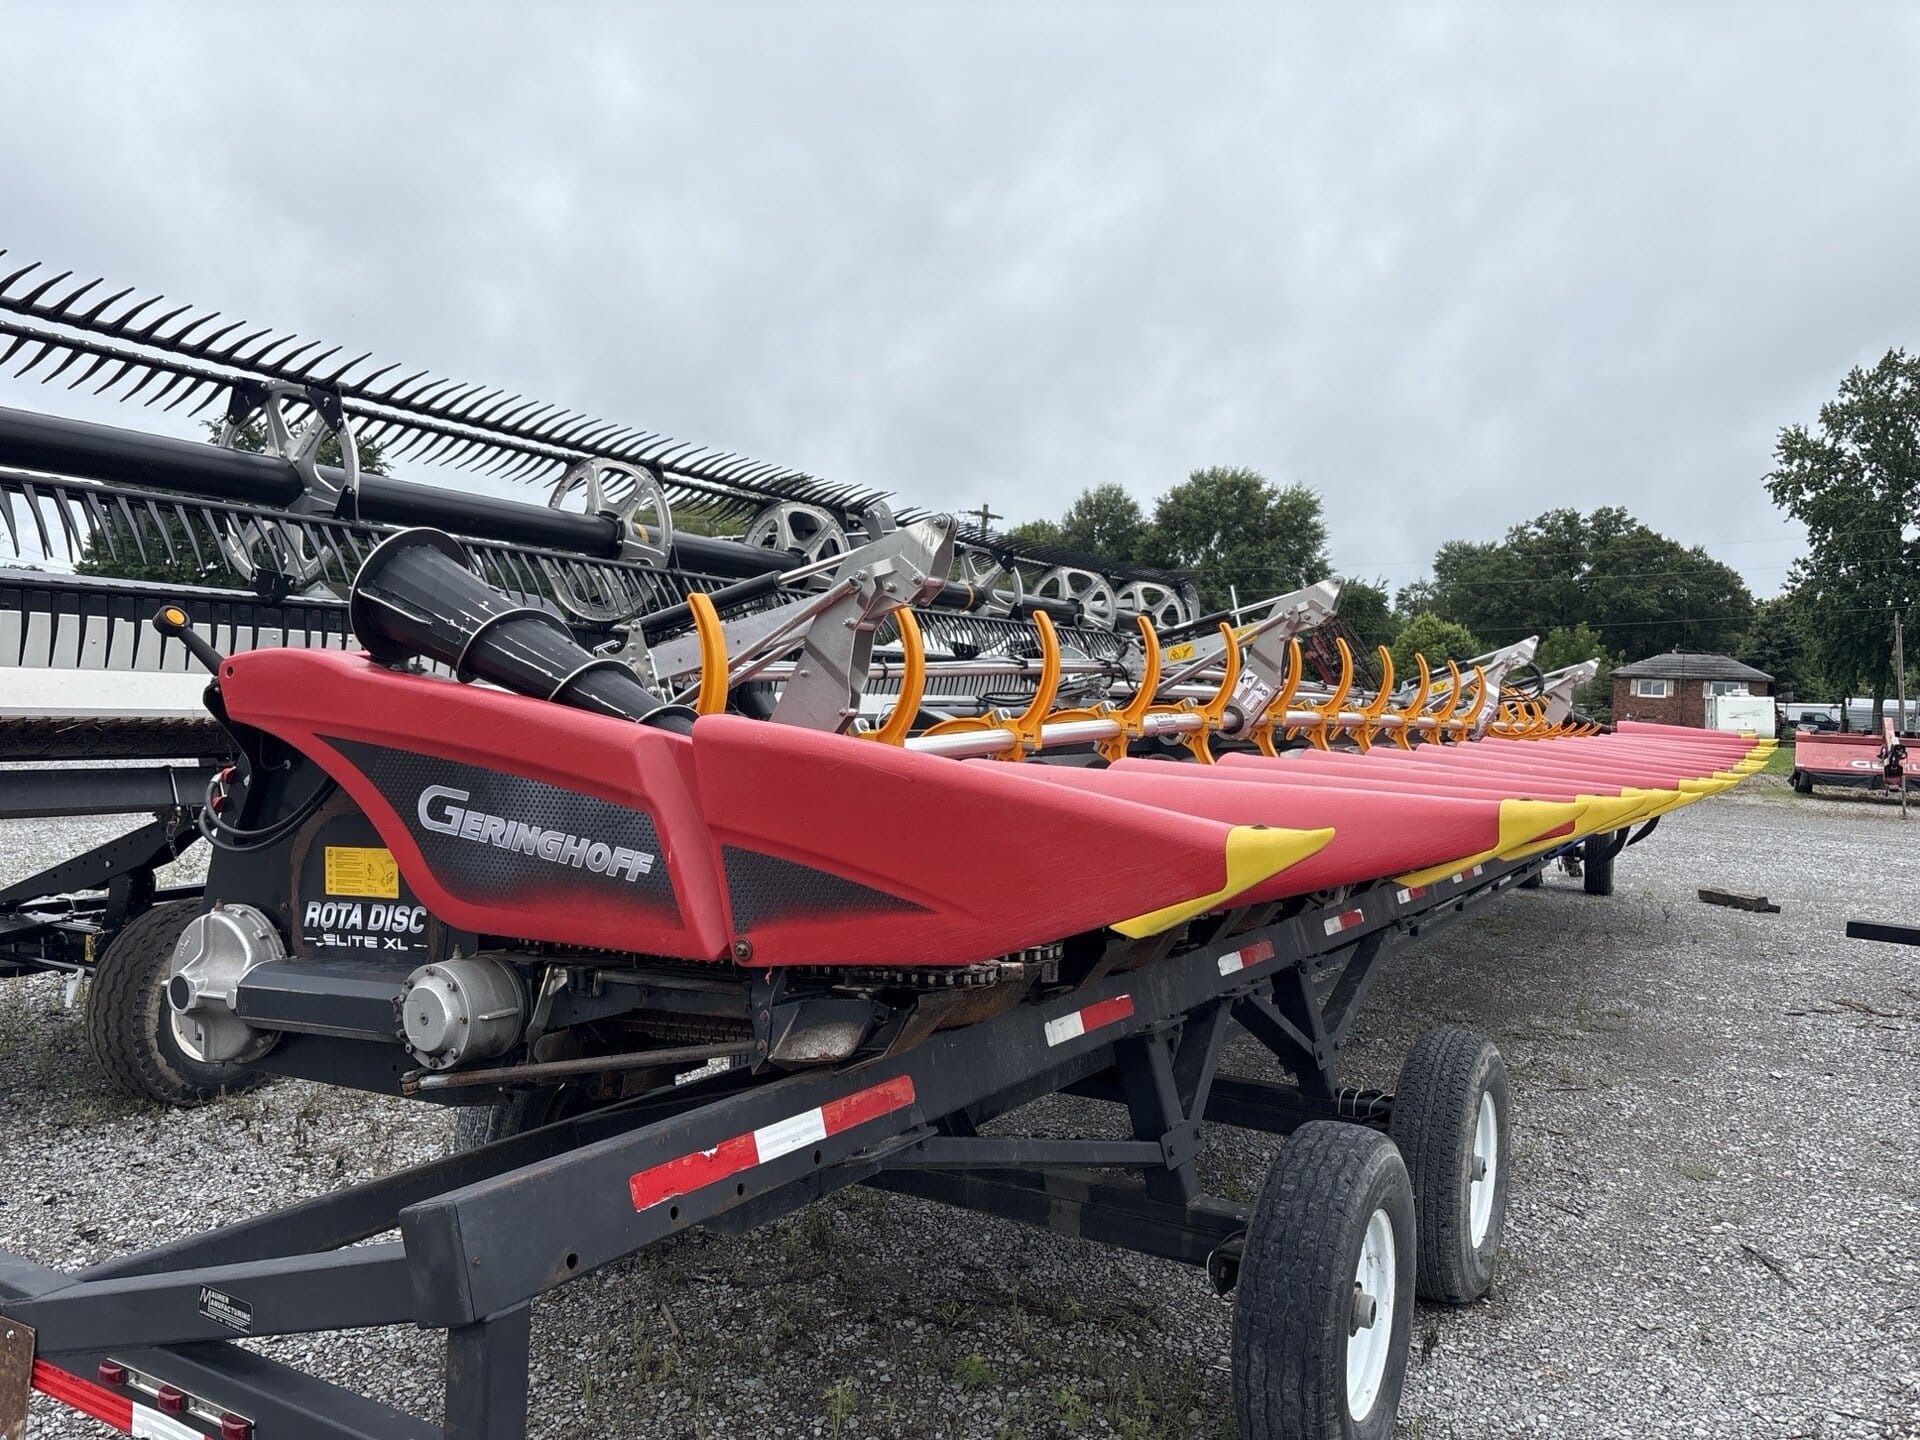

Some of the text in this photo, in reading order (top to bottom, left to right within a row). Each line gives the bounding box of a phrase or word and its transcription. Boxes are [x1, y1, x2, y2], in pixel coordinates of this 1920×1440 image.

[418, 784, 655, 881] GERINGHOFF
[304, 901, 427, 933] ROTA DISC
[322, 934, 409, 951] ELITE XL
